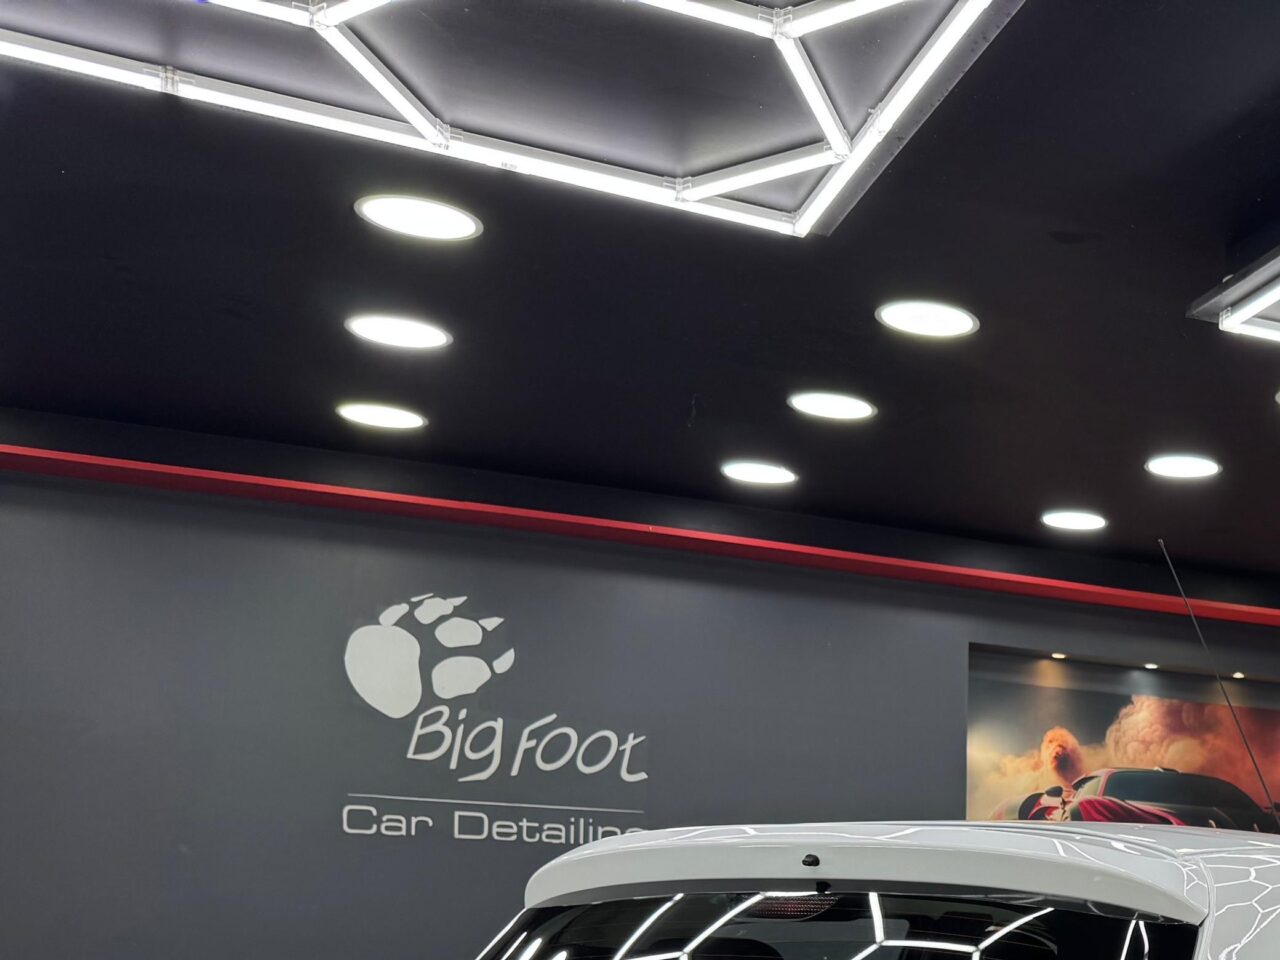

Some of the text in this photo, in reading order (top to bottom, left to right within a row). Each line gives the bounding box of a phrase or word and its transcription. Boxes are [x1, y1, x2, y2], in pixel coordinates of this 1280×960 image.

[406, 705, 503, 782] Big
[342, 804, 645, 845] Car Detailin
